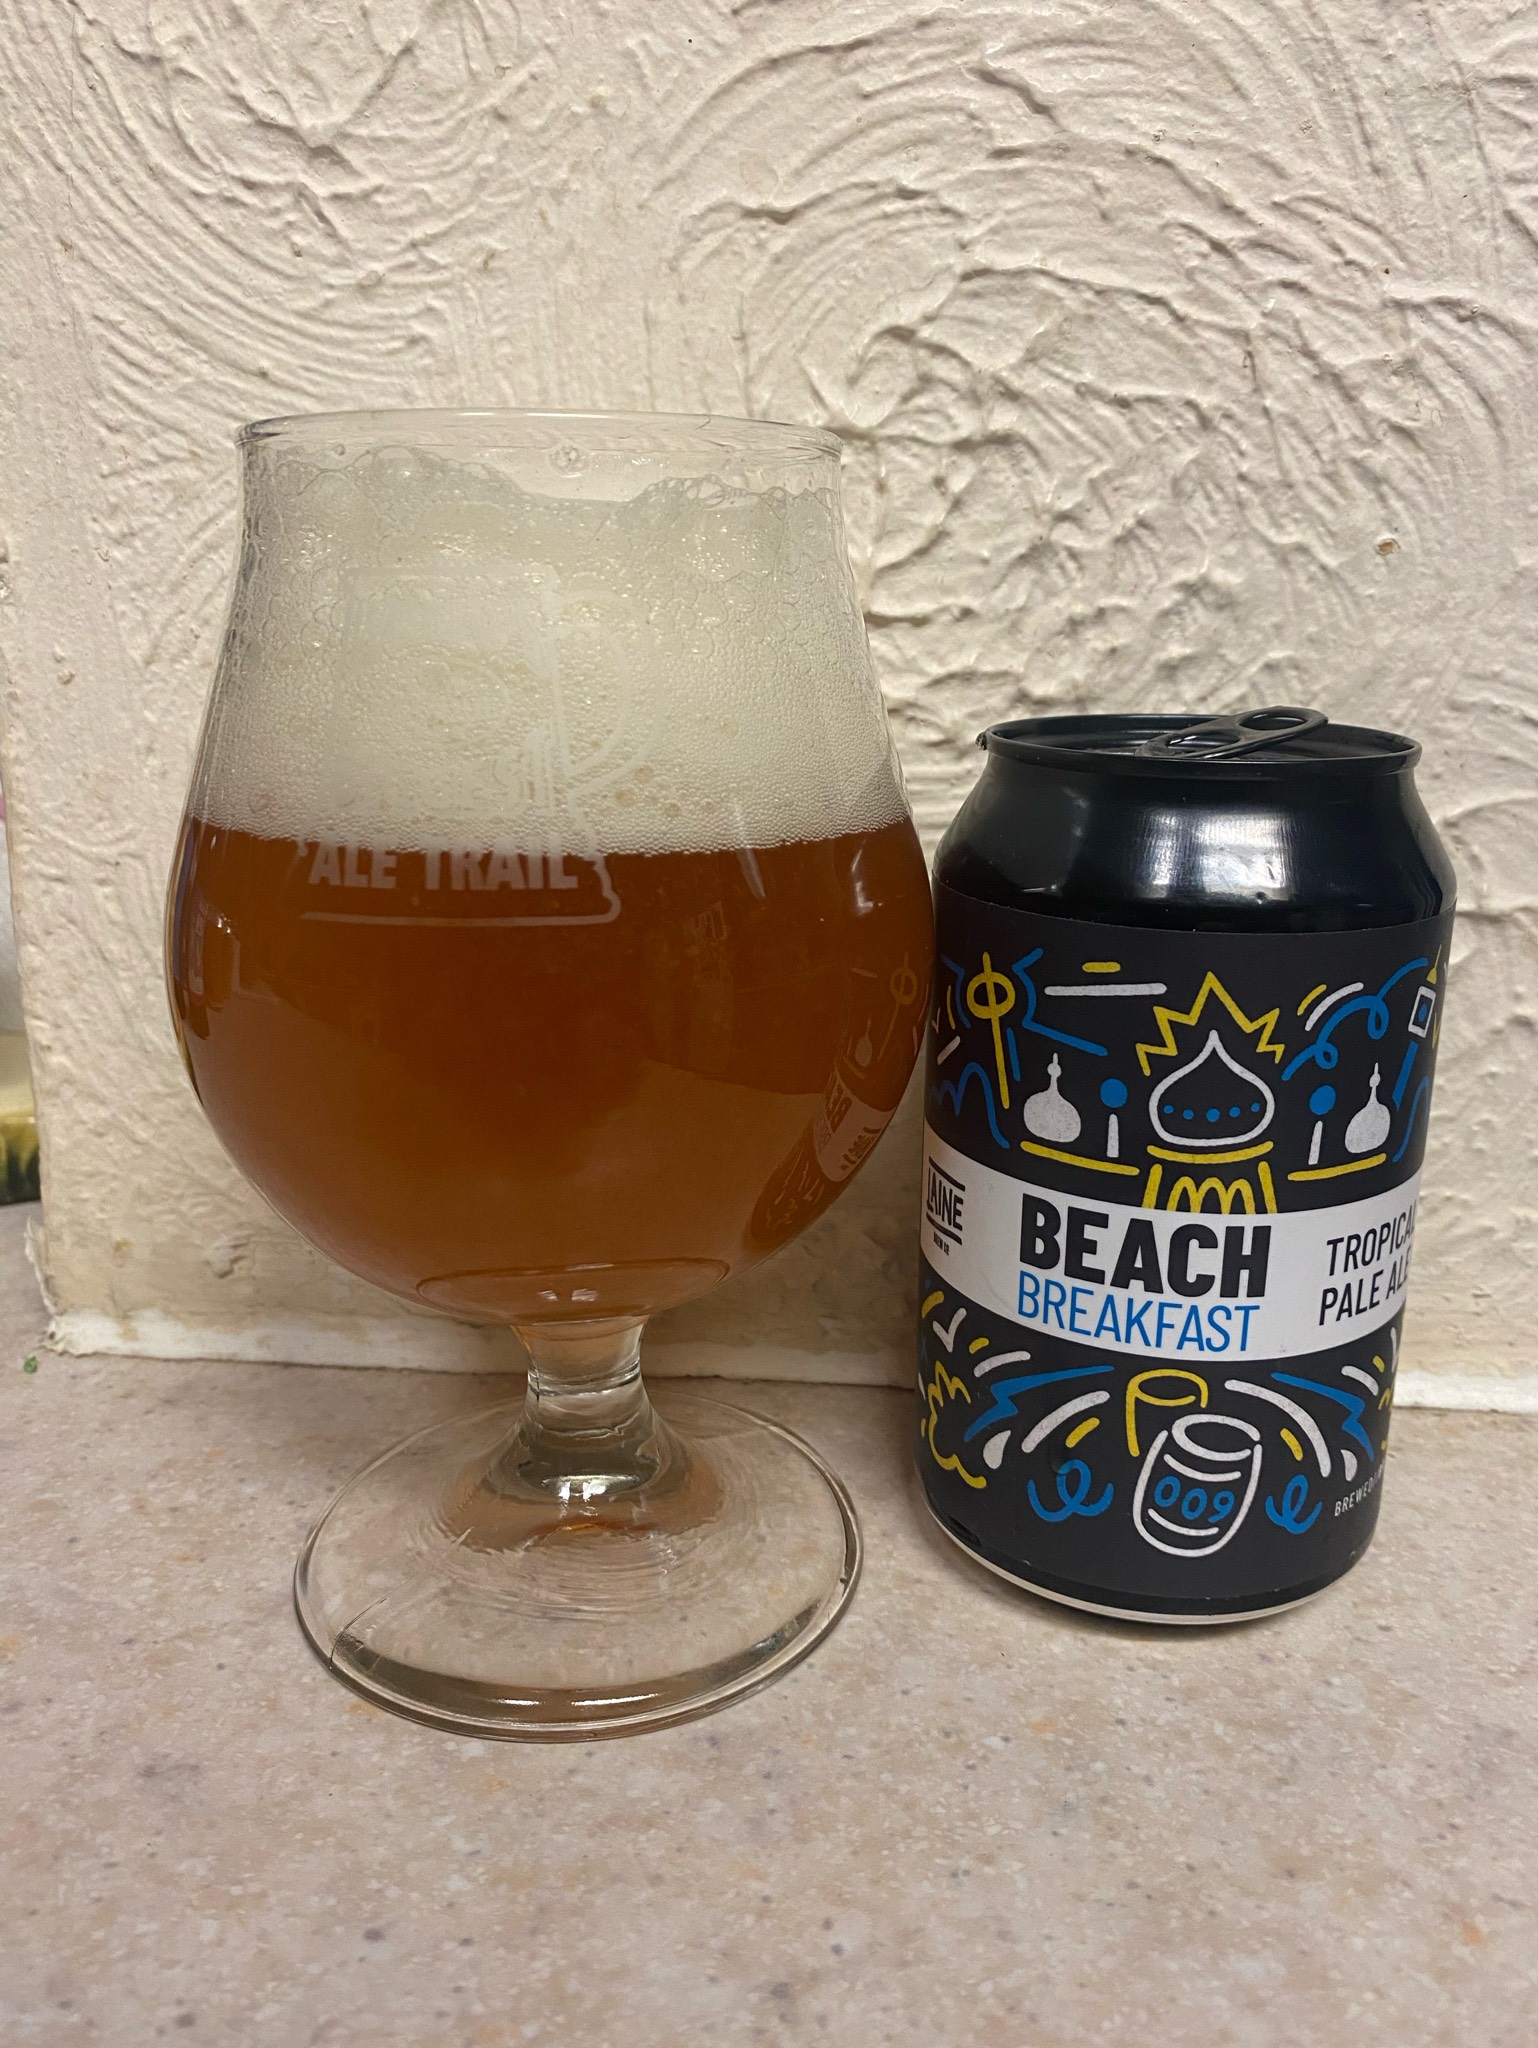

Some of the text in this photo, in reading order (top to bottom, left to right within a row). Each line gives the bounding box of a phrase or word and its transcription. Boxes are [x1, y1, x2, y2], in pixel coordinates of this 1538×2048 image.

[308, 836, 579, 891] ALE TRAIL
[926, 1167, 964, 1232] LAINE
[1019, 1193, 1272, 1299] BEACH
[1018, 1270, 1260, 1352] BREAKFAST
[1318, 1243, 1412, 1327] PALE ALE
[1154, 1475, 1236, 1523] 009
